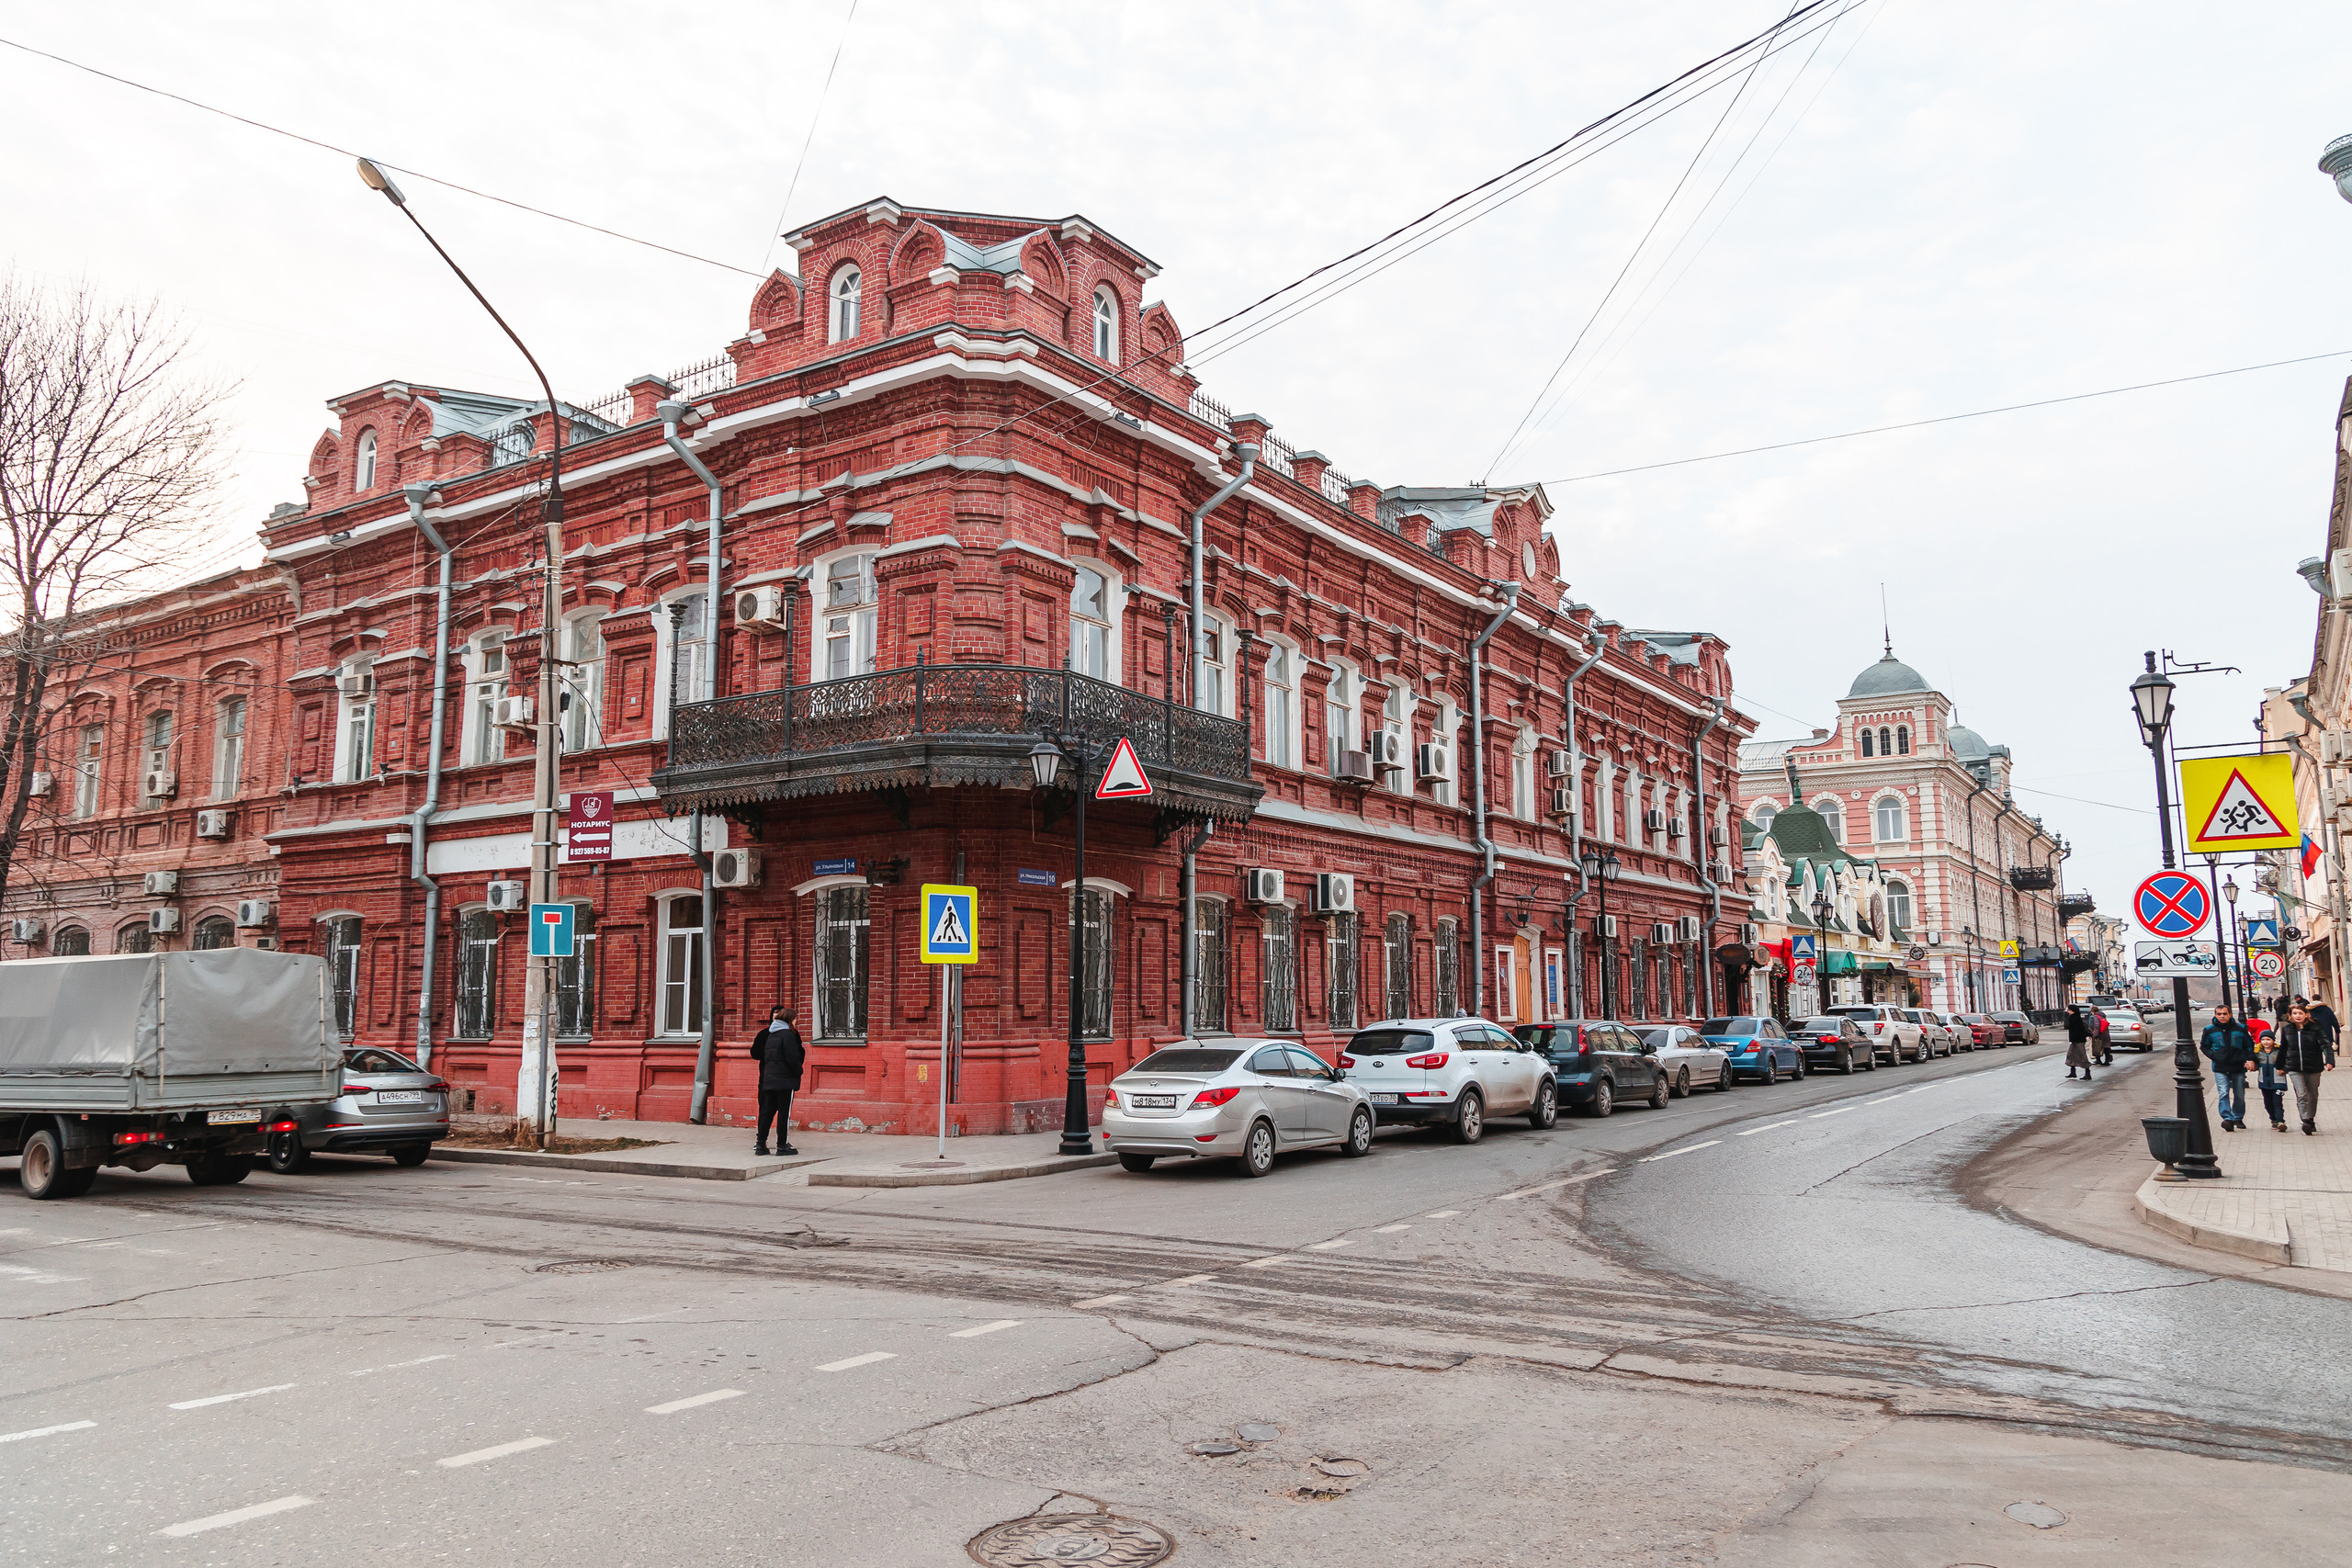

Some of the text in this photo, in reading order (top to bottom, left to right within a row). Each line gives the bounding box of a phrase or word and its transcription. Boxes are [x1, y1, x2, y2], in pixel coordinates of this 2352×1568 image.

[571, 820, 610, 829] НОТАРИУС
[574, 847, 583, 855] 927
[1048, 874, 1056, 883] 10
[2260, 959, 2278, 970] 20
[381, 1092, 409, 1100] А496СН
